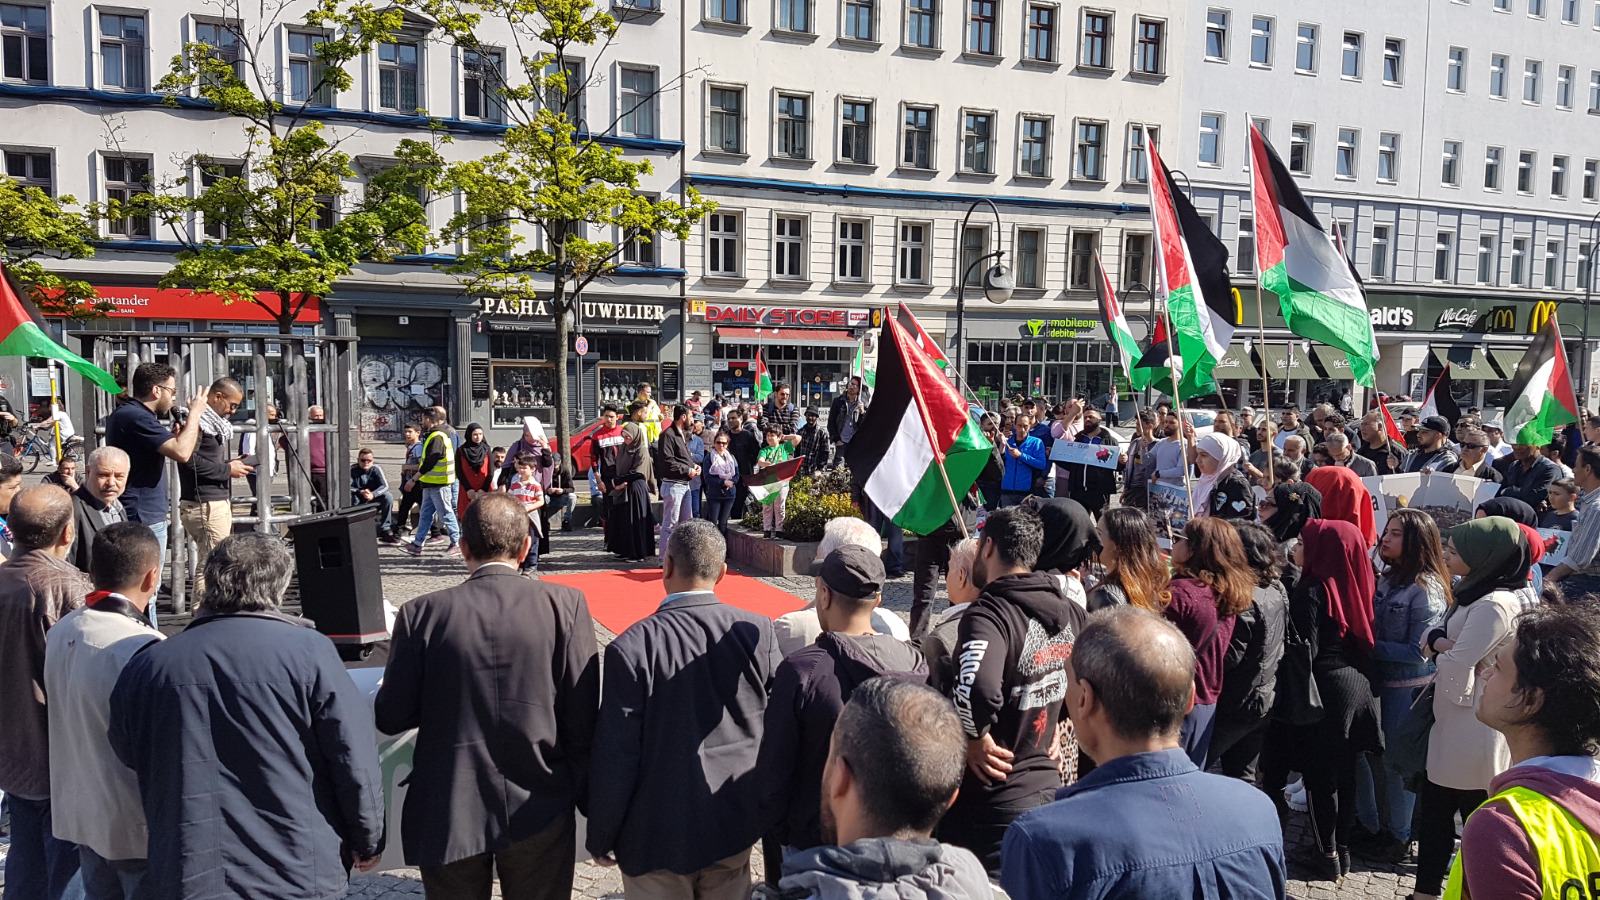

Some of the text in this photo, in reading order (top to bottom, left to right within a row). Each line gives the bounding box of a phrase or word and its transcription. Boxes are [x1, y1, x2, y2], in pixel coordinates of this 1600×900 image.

[89, 294, 150, 306] Santander
[483, 297, 549, 316] PASHA
[705, 306, 849, 325] DAILY STORE
[1050, 317, 1097, 327] mobilcom
[1372, 307, 1413, 326] ald's
[1050, 329, 1077, 338] debitel
